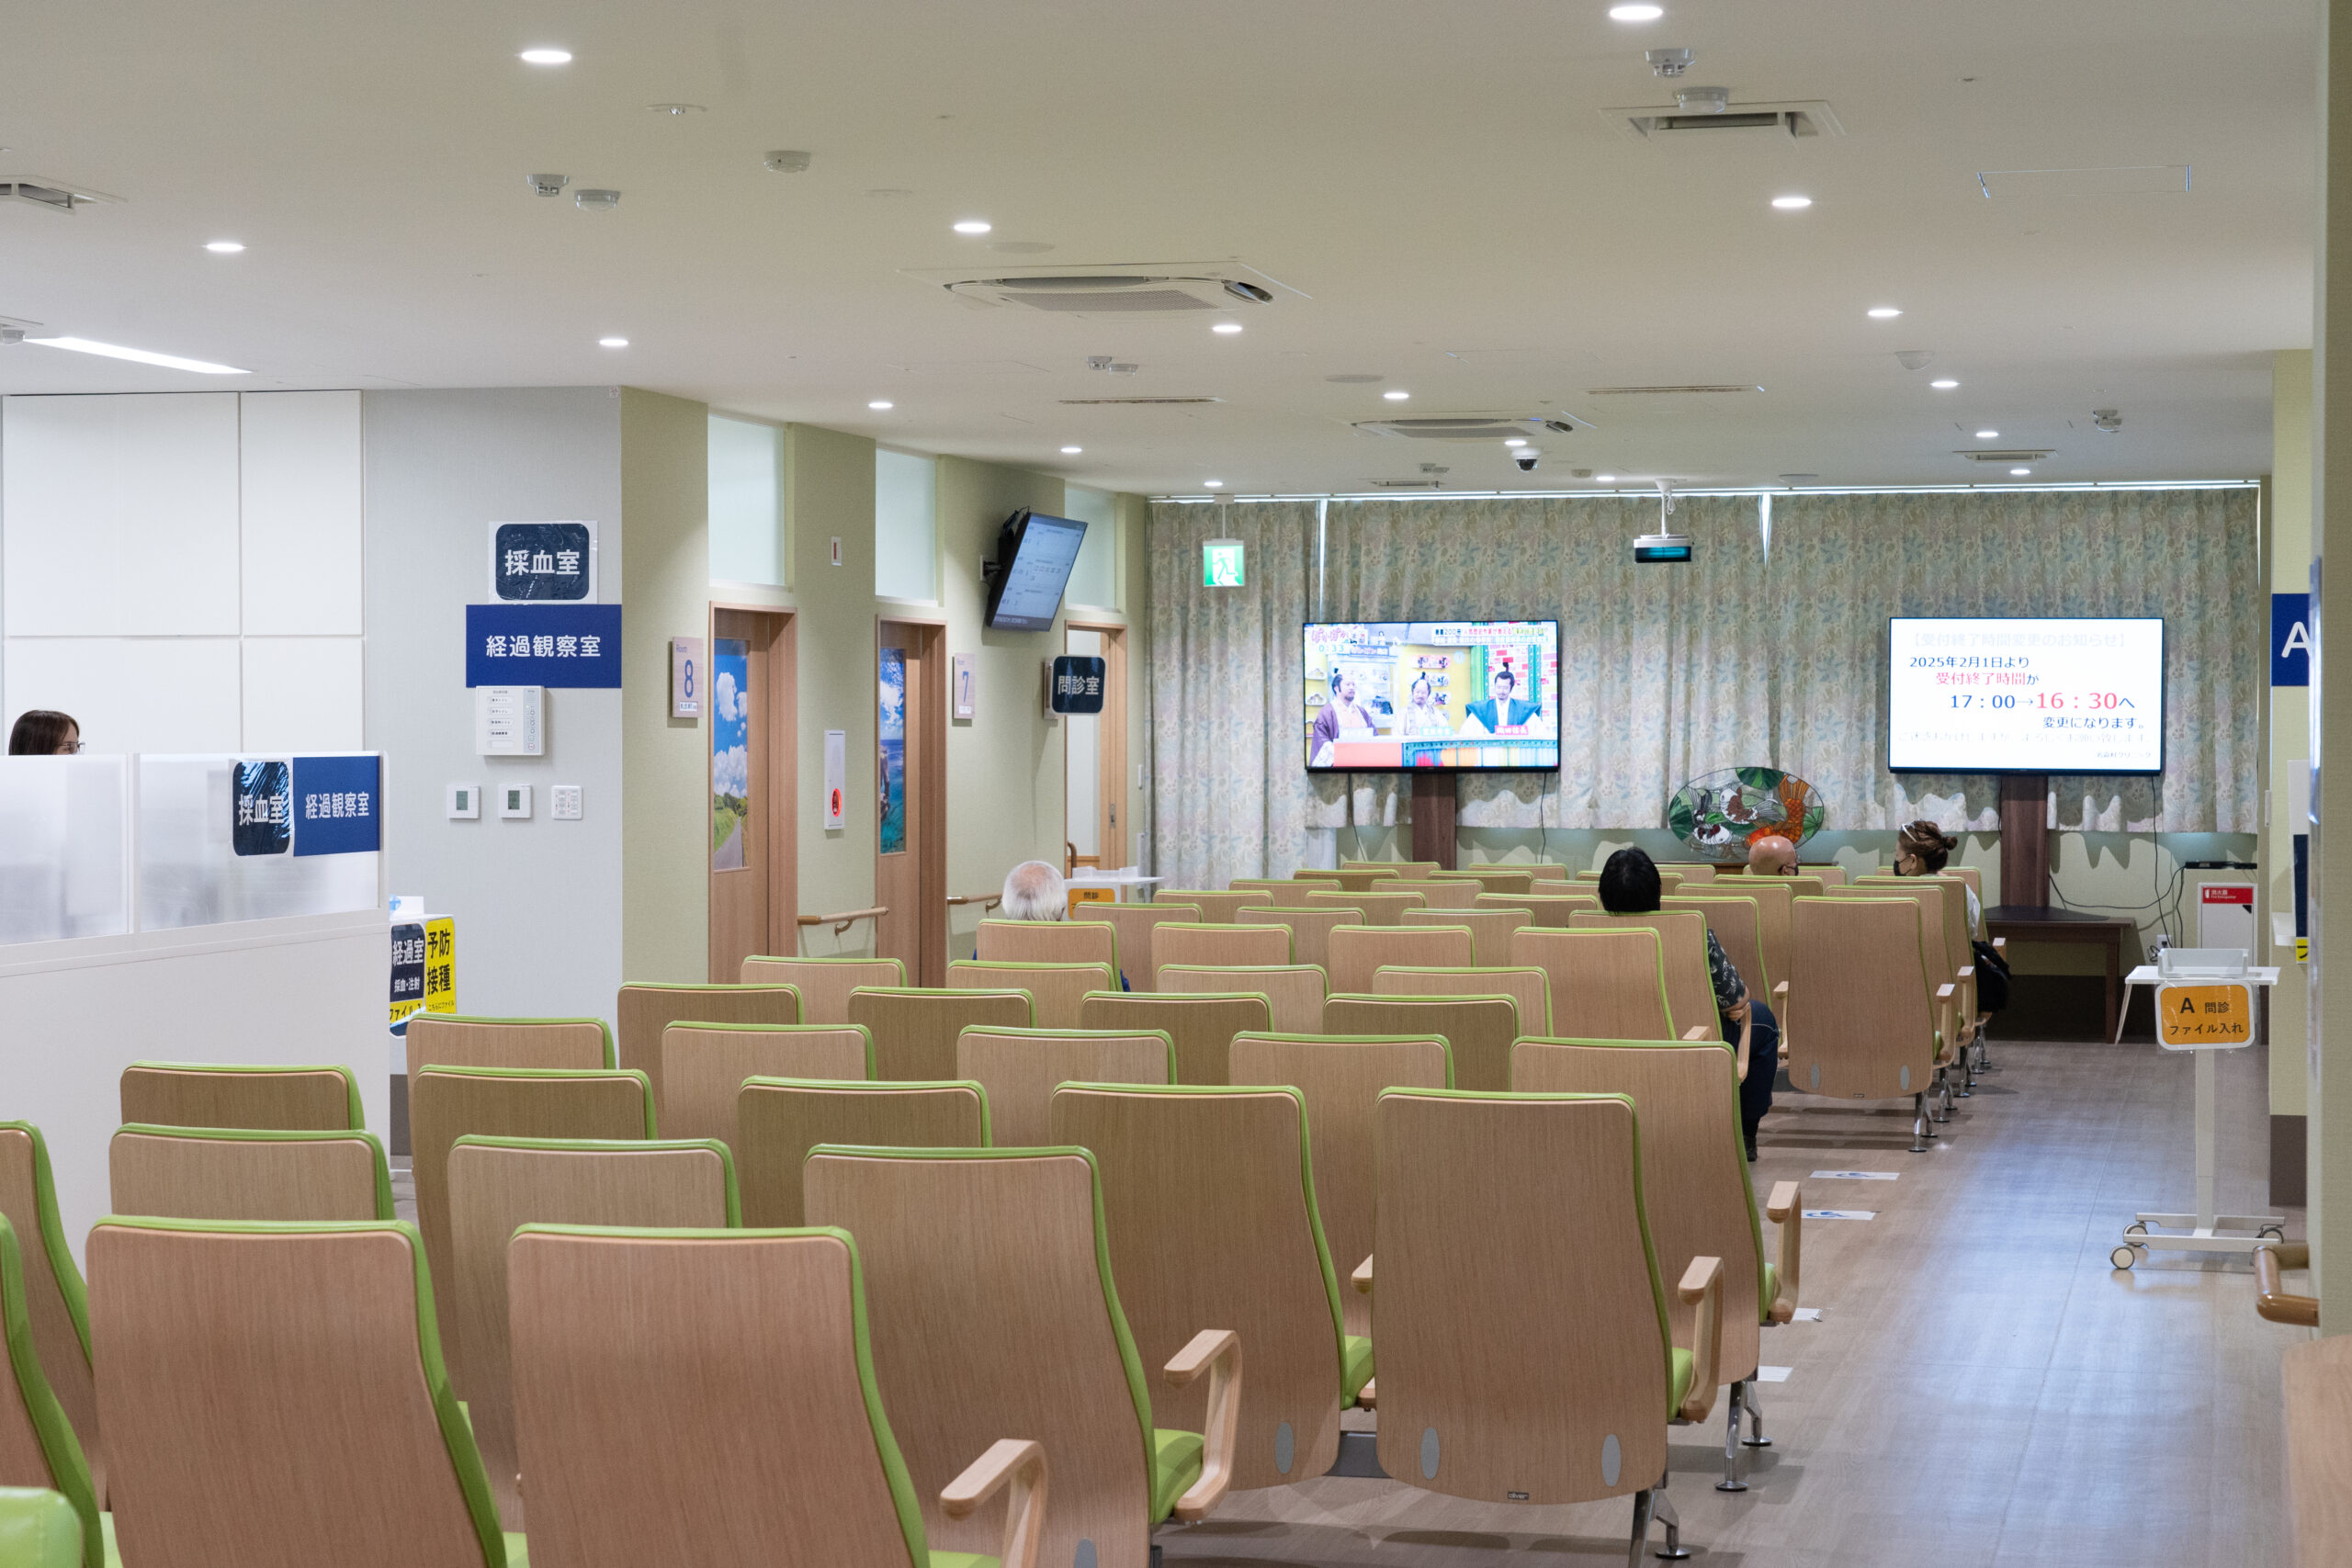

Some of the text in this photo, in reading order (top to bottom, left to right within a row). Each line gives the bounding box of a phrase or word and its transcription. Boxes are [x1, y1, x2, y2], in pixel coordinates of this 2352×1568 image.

[504, 549, 581, 576] 採血室
[486, 635, 601, 658] 経過観察室
[2281, 621, 2309, 659] A
[1909, 656, 2030, 668] 2025年2月1日より
[684, 660, 694, 698] 8
[962, 671, 969, 703] 7
[1057, 675, 1100, 695] 問診室
[2042, 716, 2144, 729] 変更になります。
[238, 793, 285, 826] 採血室
[305, 792, 369, 819] 経過観察室
[392, 938, 424, 966] 経過室
[427, 928, 451, 959] 予防
[394, 976, 421, 993] 採血・注射
[427, 964, 452, 996] 接種
[2180, 998, 2229, 1014] A 問診
[2169, 1022, 2244, 1035] ファイル入れ
